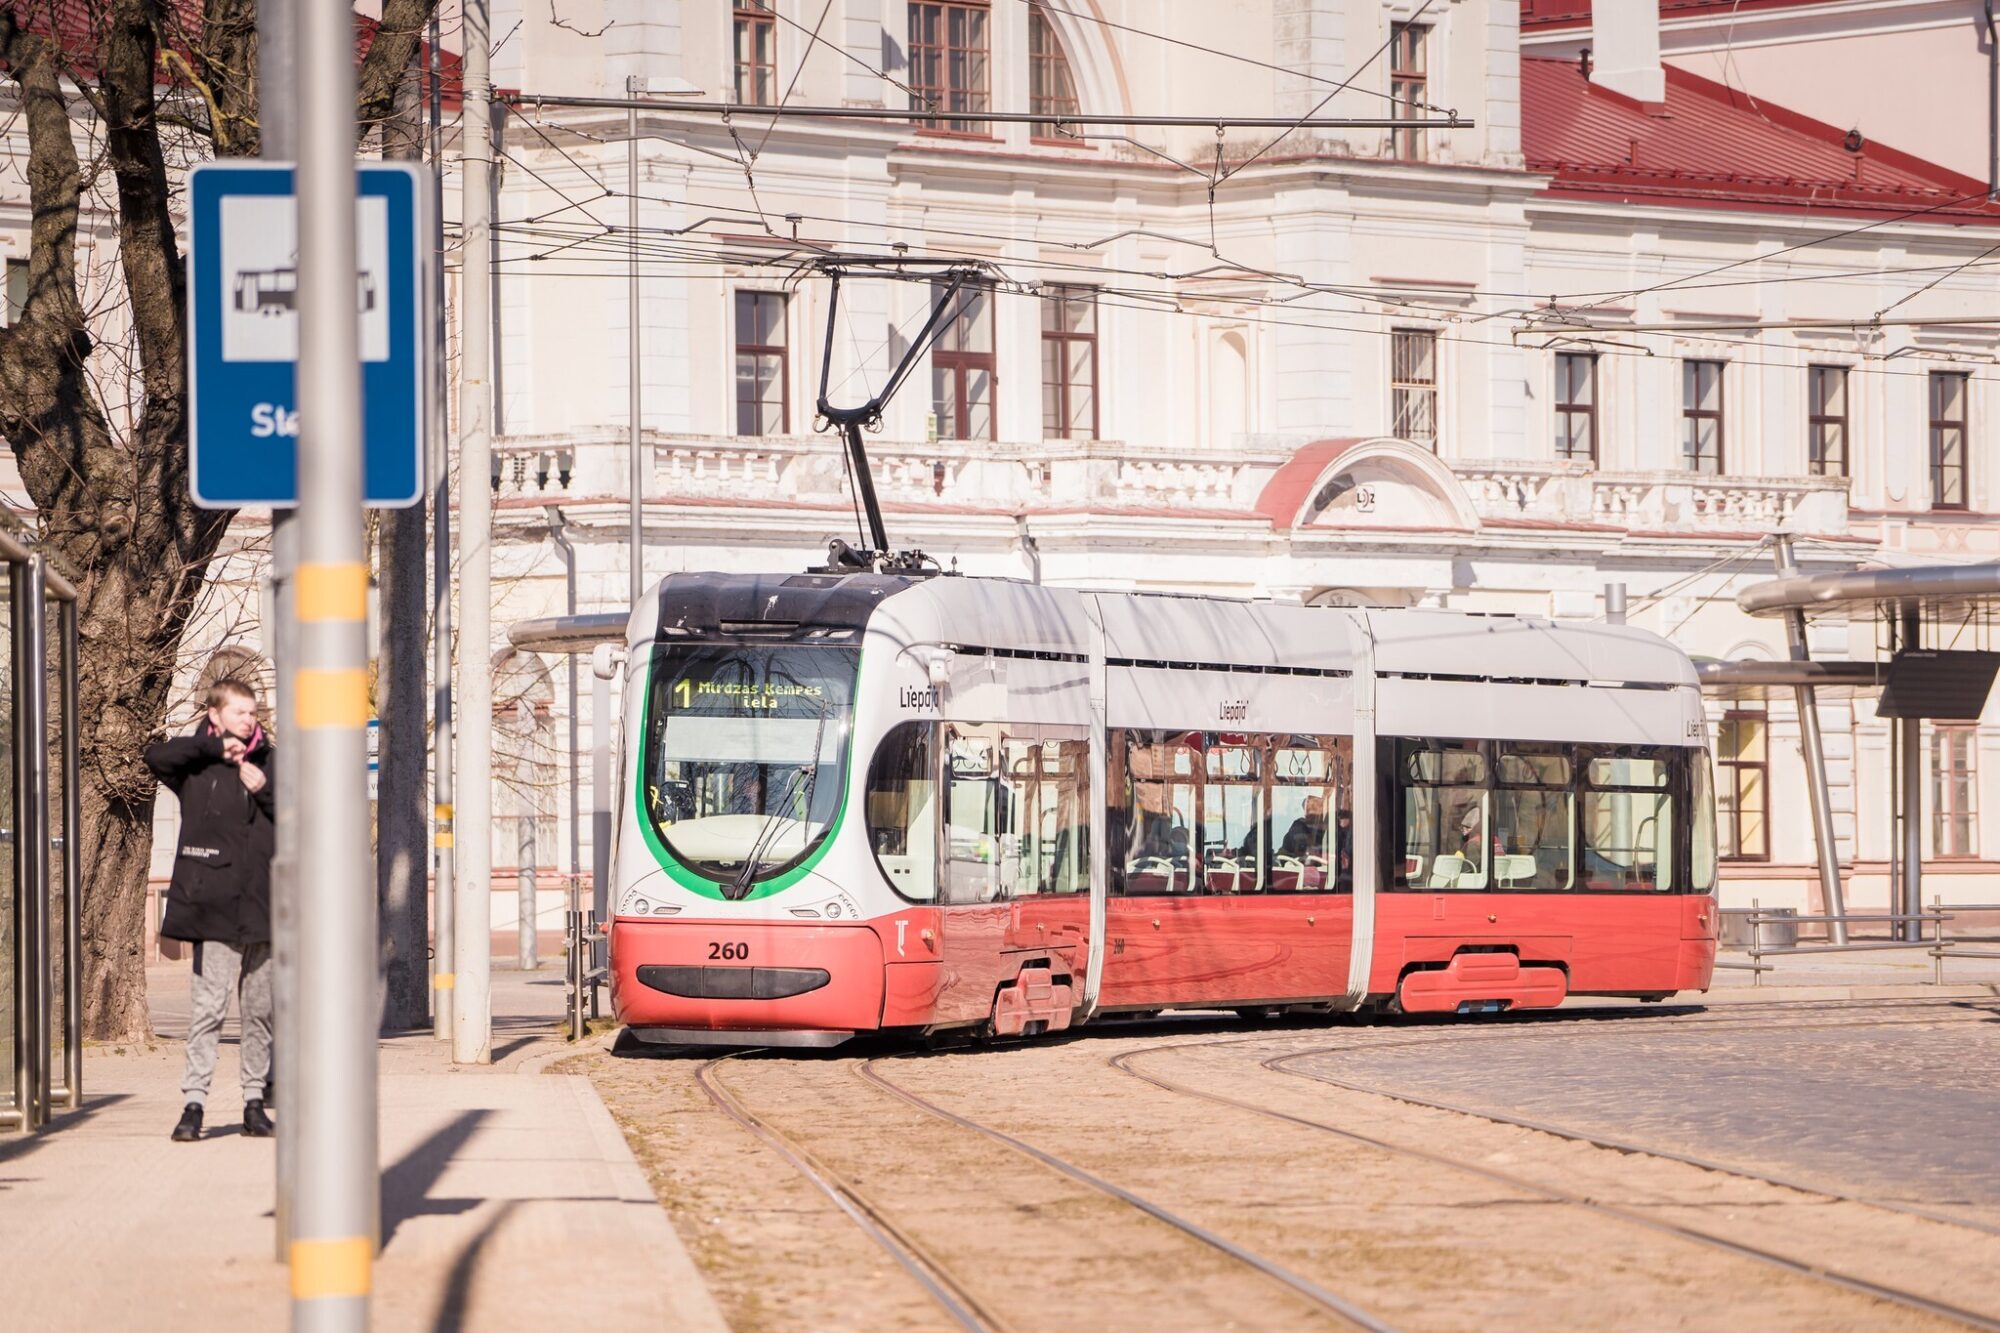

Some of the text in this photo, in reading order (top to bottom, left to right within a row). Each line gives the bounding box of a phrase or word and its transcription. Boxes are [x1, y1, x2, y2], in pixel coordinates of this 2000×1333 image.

[674, 678, 691, 709] 1
[698, 681, 759, 694] Mirdzas
[743, 695, 778, 708] iela
[708, 941, 749, 960] 260
